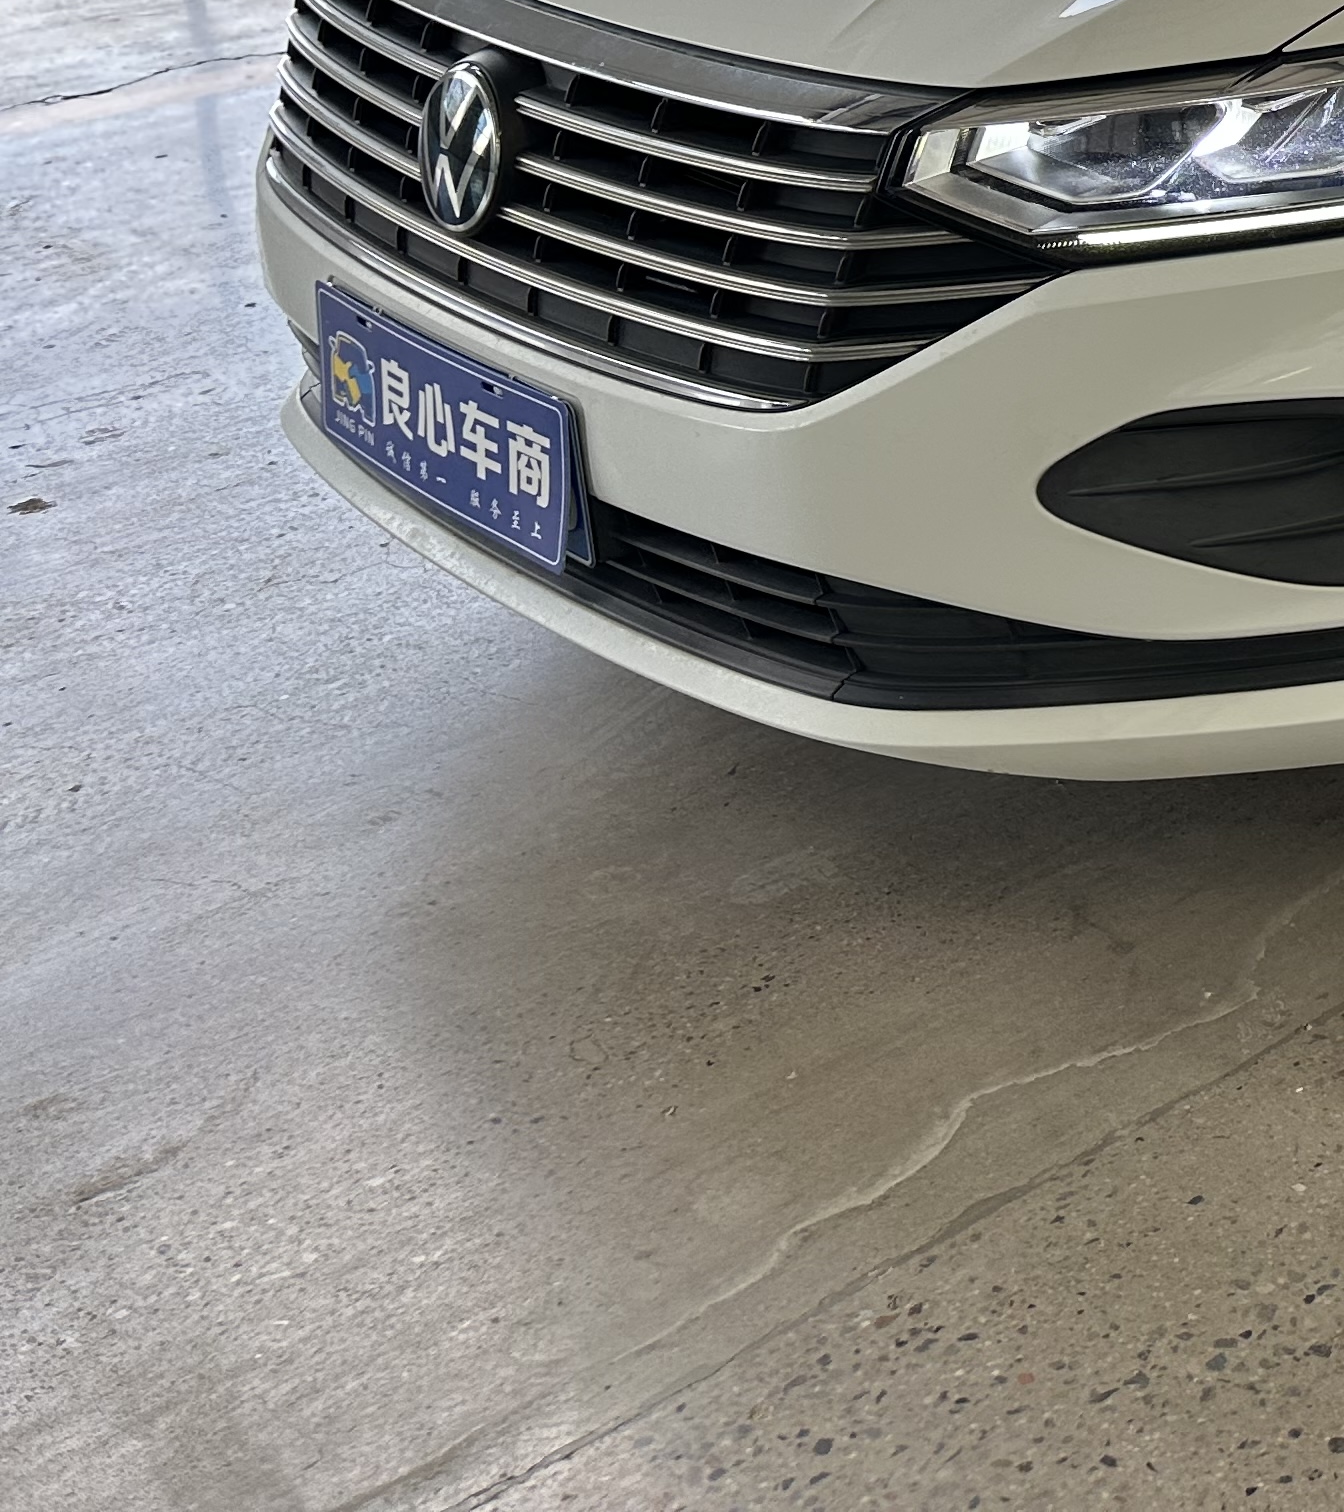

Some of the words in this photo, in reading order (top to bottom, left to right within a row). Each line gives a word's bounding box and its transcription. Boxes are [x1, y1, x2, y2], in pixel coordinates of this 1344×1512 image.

[358, 425, 375, 446] PIN
[380, 358, 551, 509] 良心车商
[470, 489, 543, 539] 服务至上
